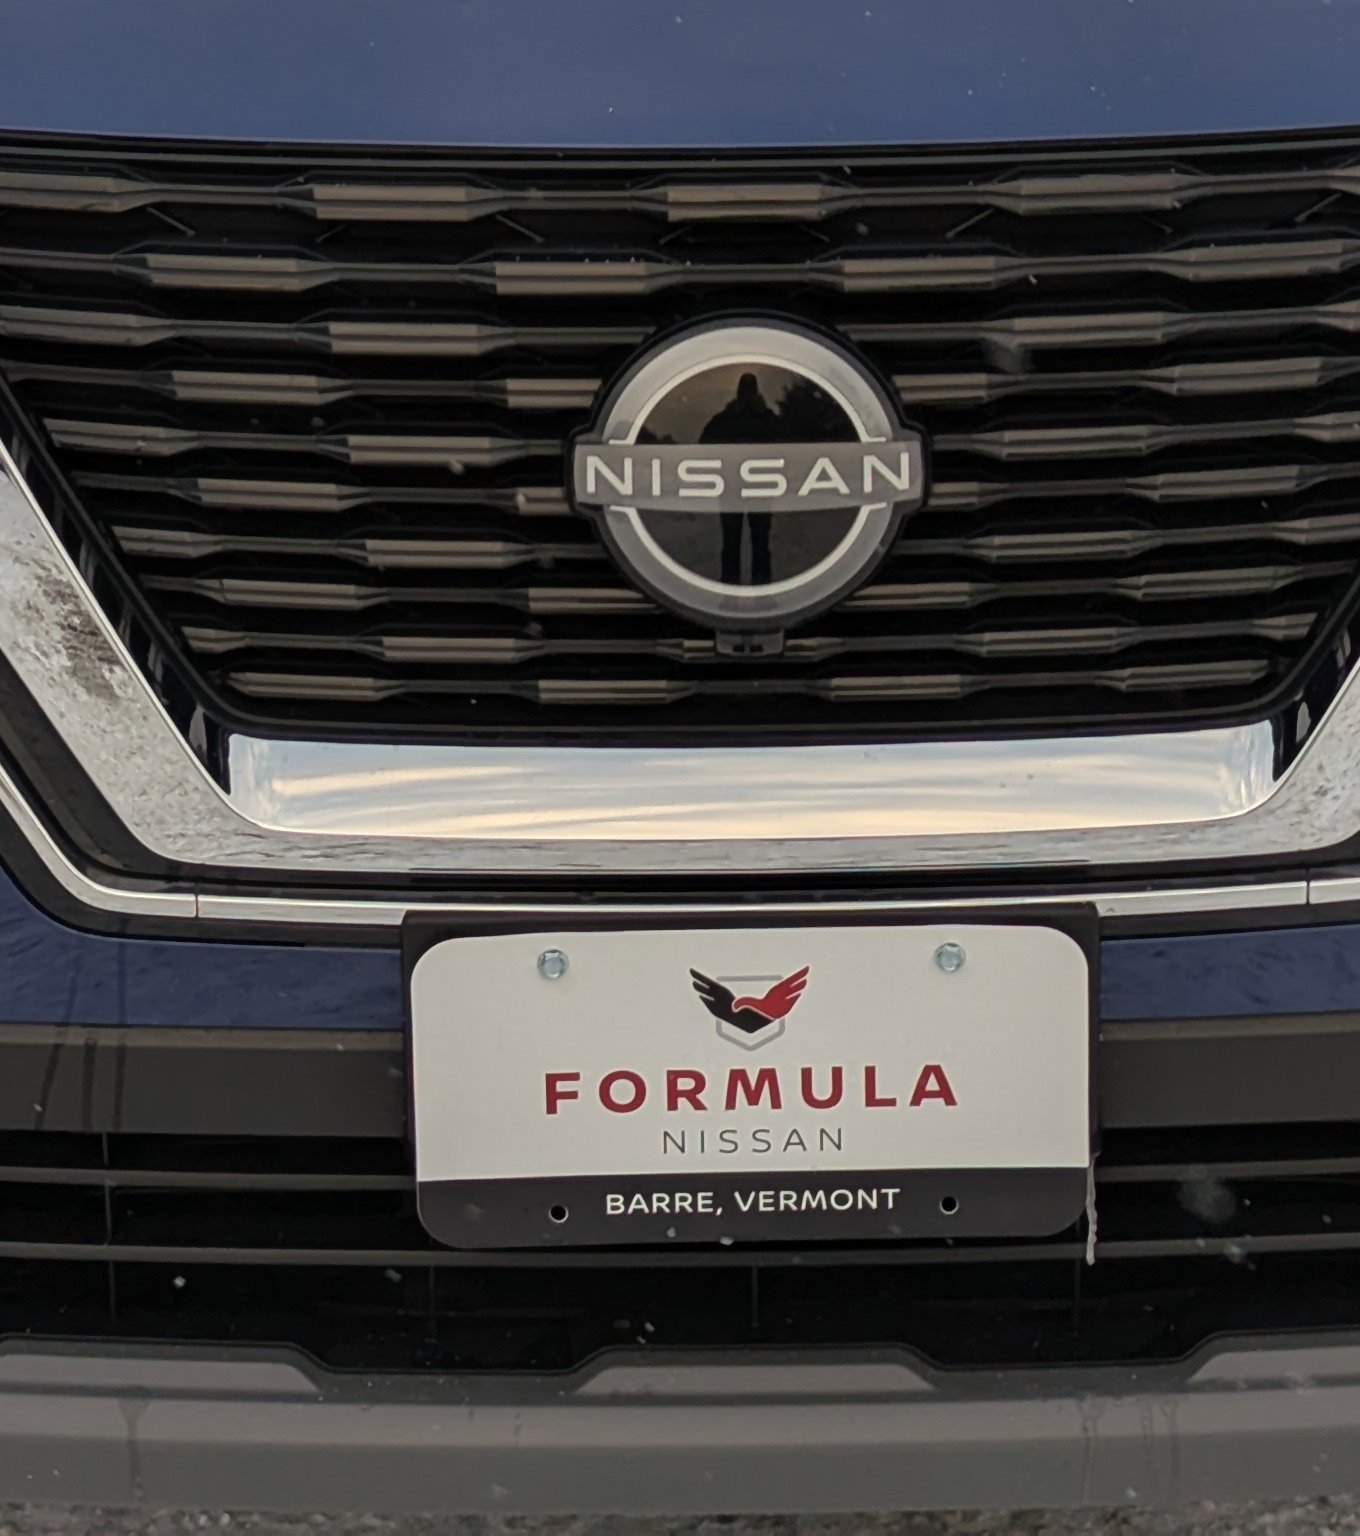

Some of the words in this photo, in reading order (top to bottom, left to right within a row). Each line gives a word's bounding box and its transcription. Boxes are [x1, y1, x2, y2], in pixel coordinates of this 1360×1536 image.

[586, 452, 910, 497] NISSAN
[544, 1064, 959, 1116] FORMULA
[662, 1127, 844, 1155] NISSAN
[605, 1192, 724, 1216] BARRE,
[734, 1188, 901, 1213] VERMONT
